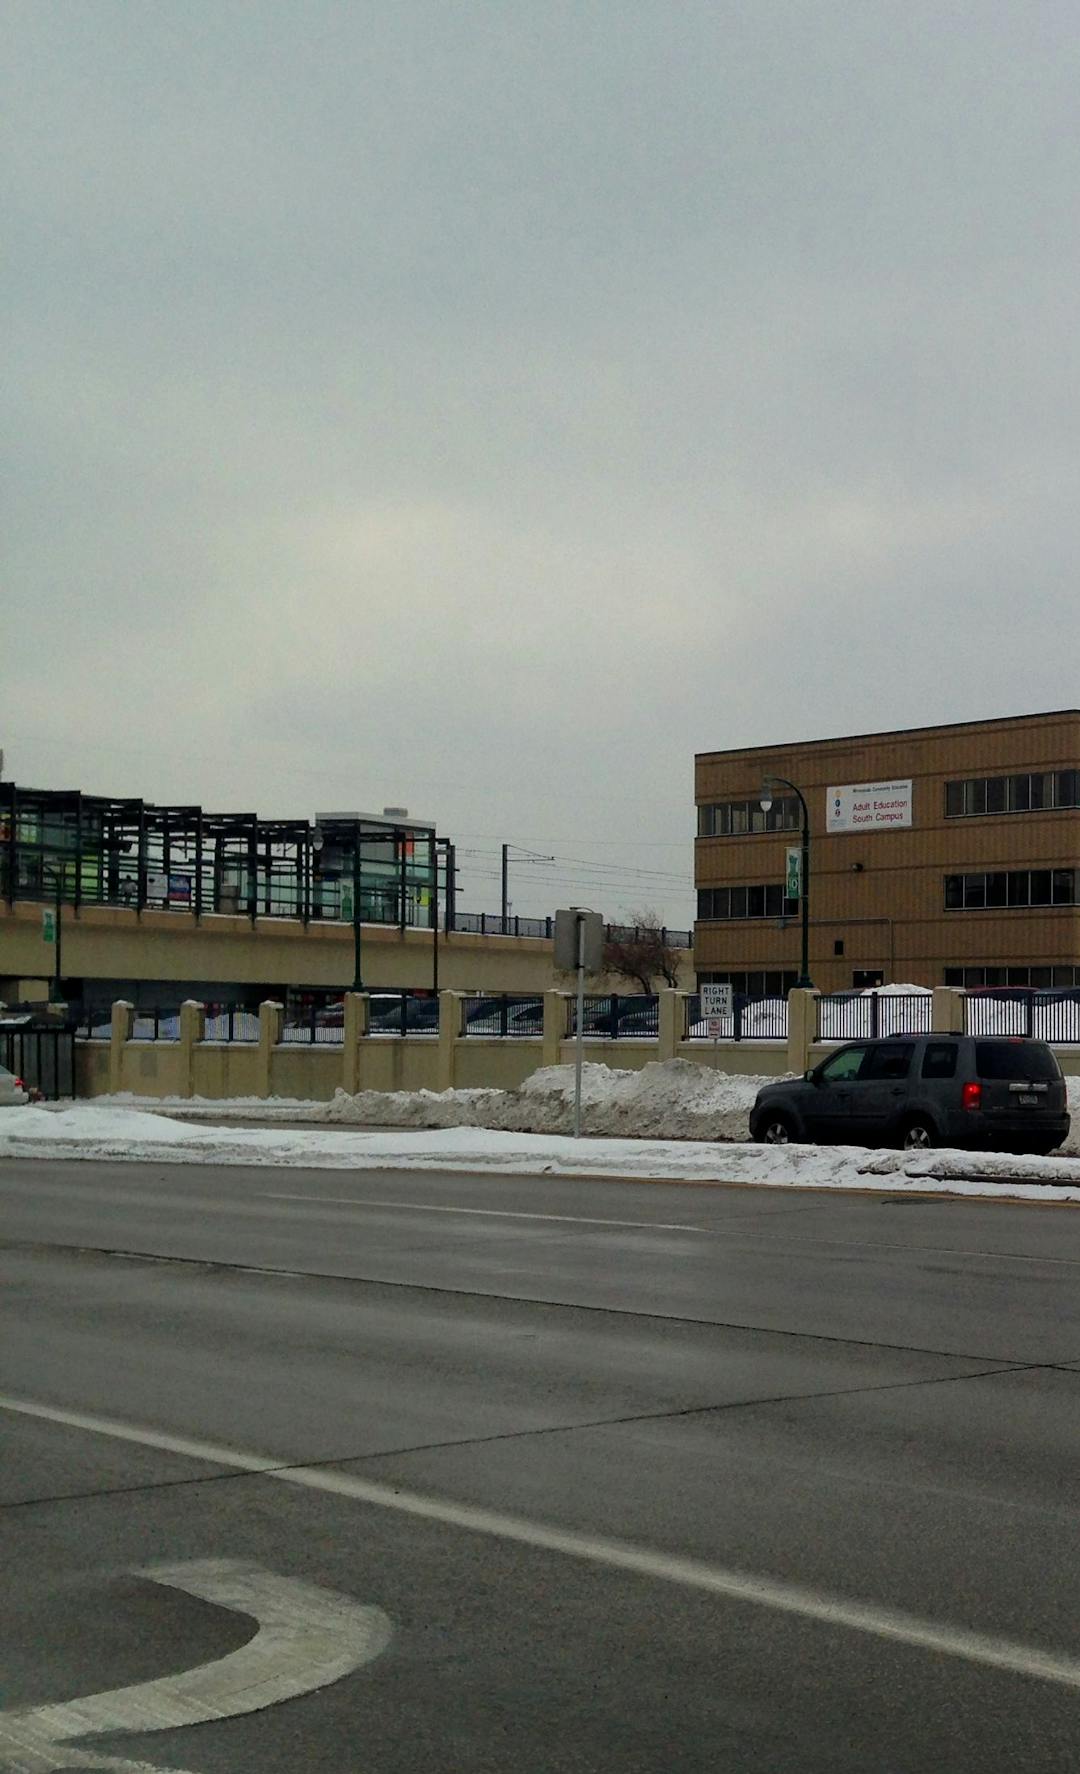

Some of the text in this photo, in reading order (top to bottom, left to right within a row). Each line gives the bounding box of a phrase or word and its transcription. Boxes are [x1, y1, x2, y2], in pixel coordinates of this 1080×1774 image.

[853, 800, 908, 812] Adult Education
[852, 813, 873, 824] South
[875, 812, 903, 822] Campus
[703, 986, 730, 995] RIGHT
[705, 996, 728, 1005] TURN
[704, 1006, 728, 1015] LANE
